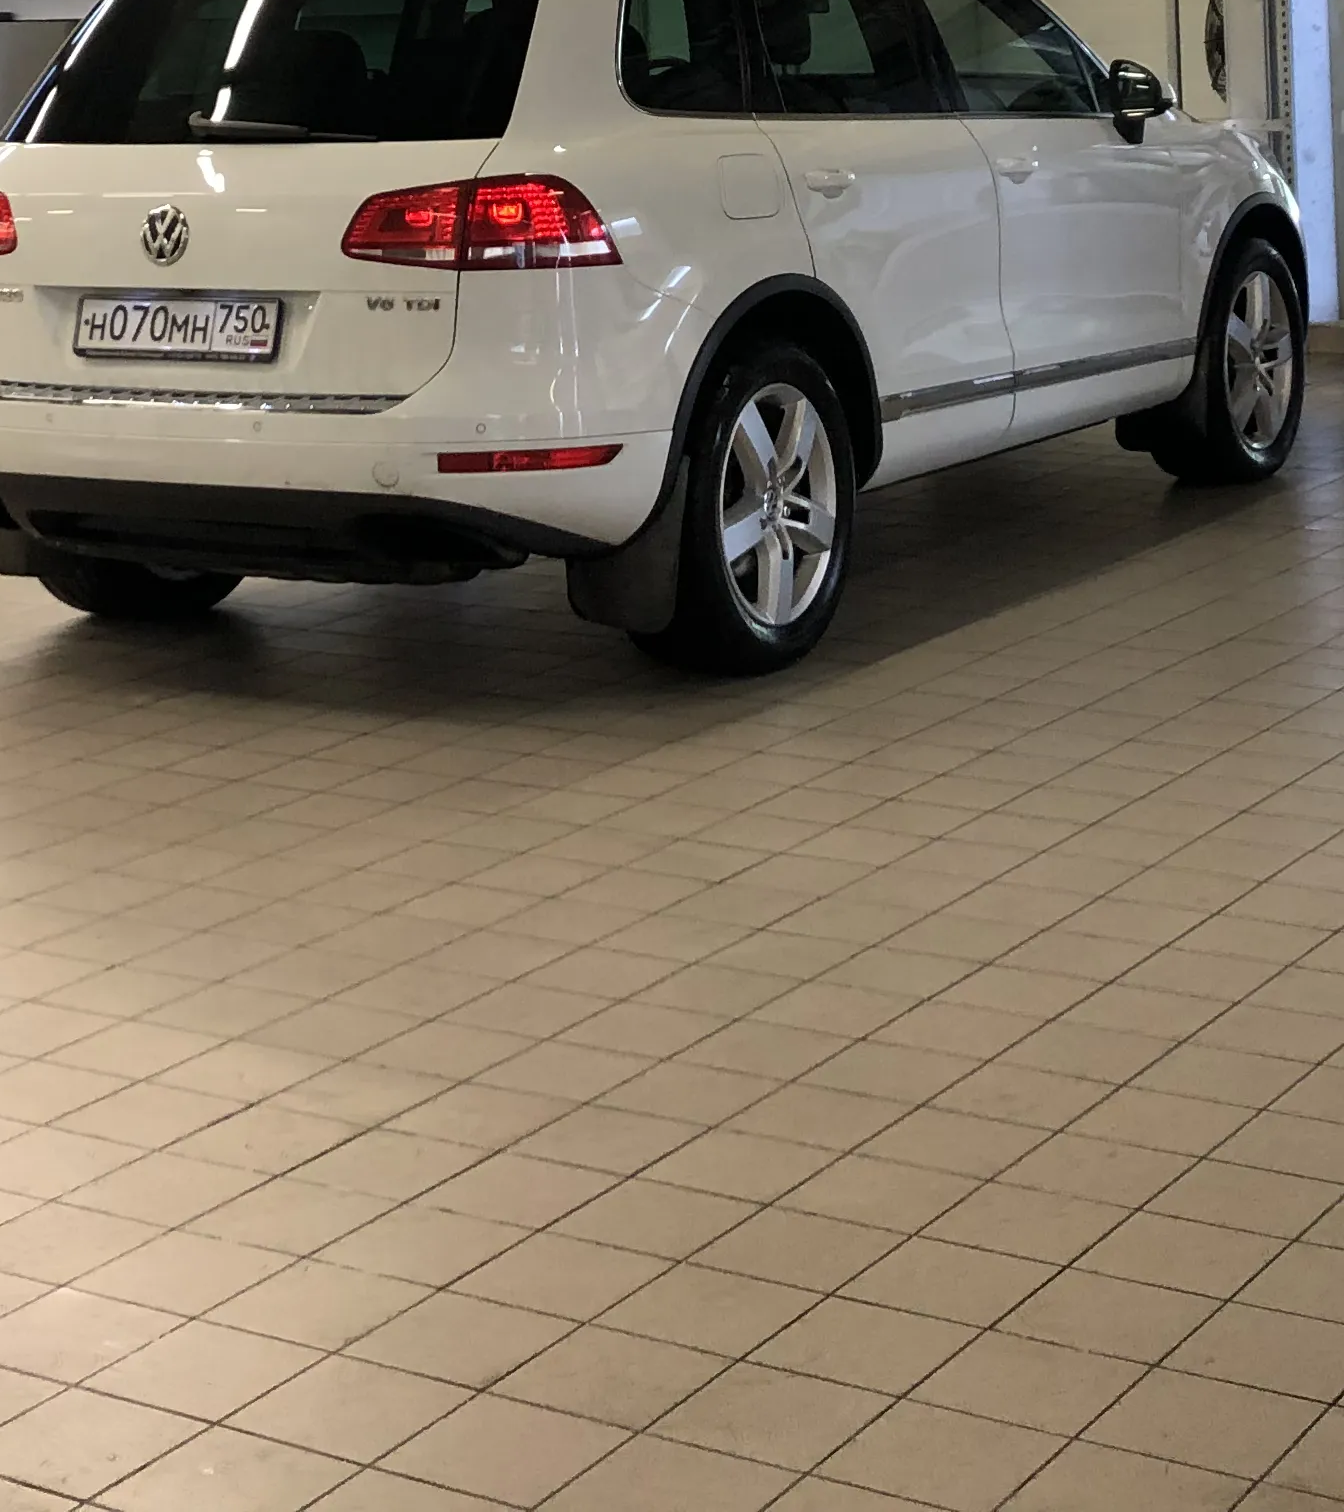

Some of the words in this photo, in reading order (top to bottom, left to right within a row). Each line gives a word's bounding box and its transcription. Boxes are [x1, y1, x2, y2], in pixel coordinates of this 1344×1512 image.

[404, 297, 440, 311] TDI
[218, 303, 267, 334] 750
[225, 334, 250, 347] RUS
